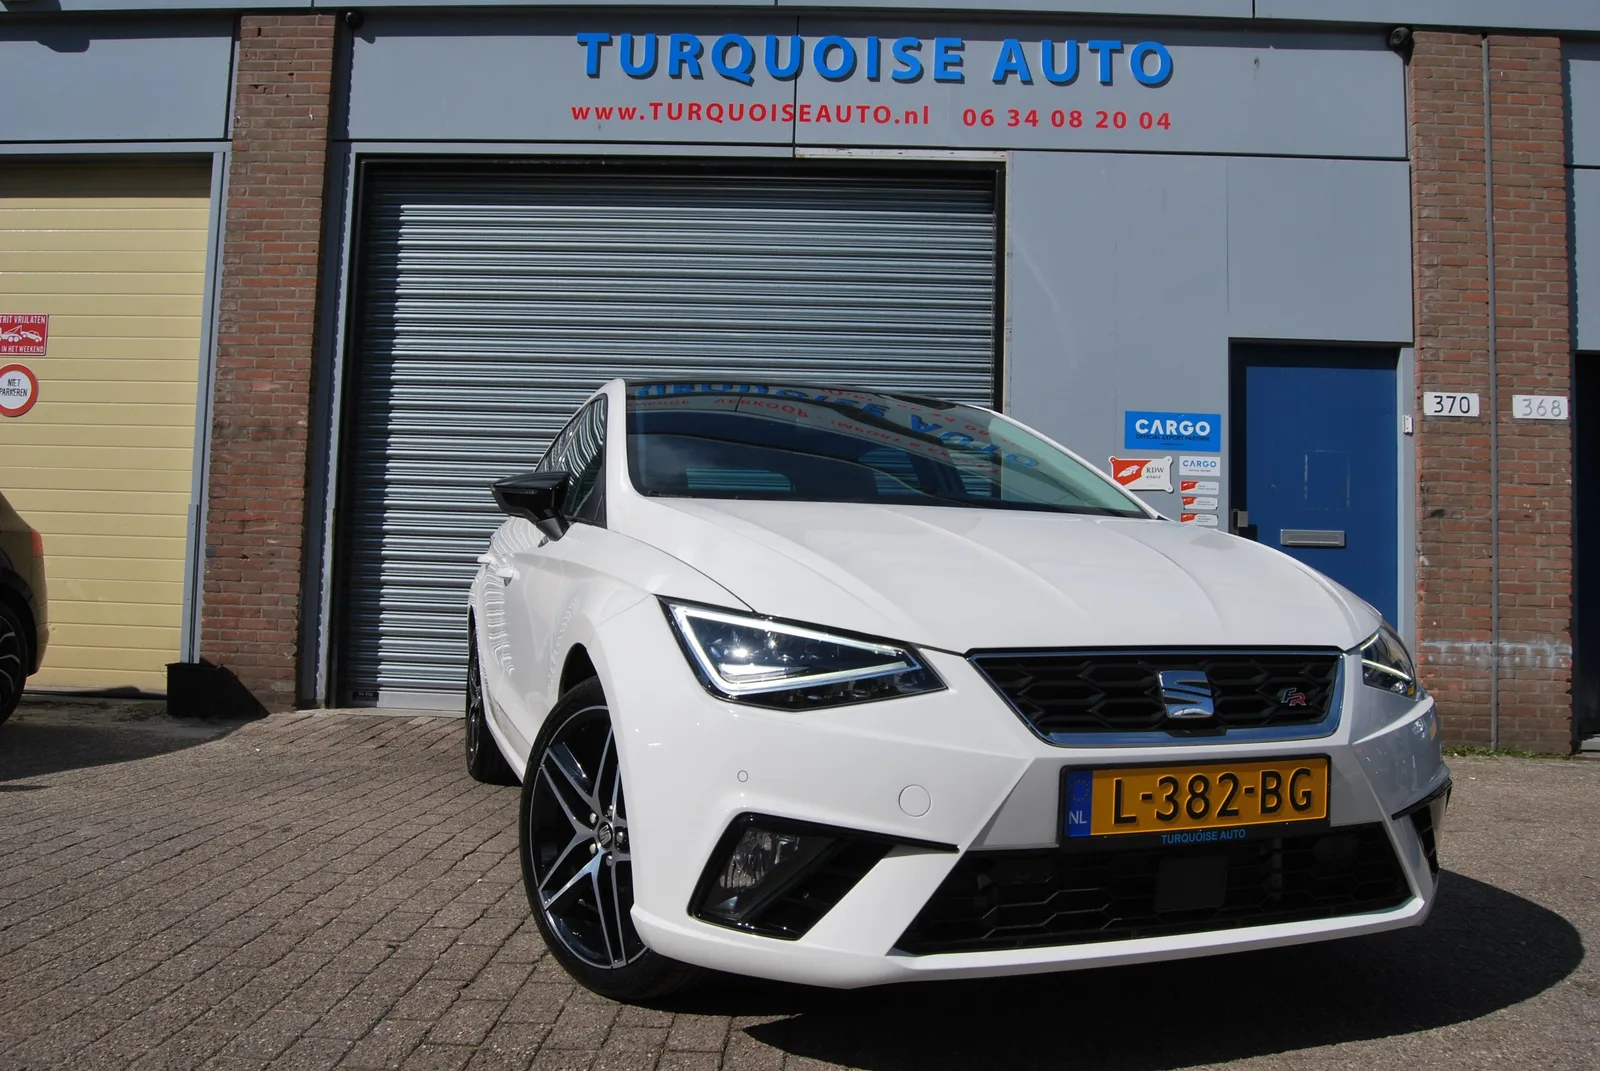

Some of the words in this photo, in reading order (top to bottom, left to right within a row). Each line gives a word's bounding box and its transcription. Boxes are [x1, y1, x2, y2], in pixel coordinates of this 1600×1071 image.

[576, 33, 965, 86] TURQUOISE
[992, 39, 1173, 87] AUTO
[571, 102, 929, 124] www.TURQUOISEAUTO.nl
[962, 109, 995, 127] 06
[1007, 109, 1039, 128] 34
[1051, 110, 1083, 128] 08
[1095, 110, 1127, 129] 20
[1139, 112, 1171, 130] 04
[14, 315, 45, 323] VRIJLATEN
[7, 378, 21, 387] NIET
[1433, 395, 1470, 414] 370
[1521, 398, 1562, 417] 368
[1135, 419, 1210, 436] CARGO
[1183, 460, 1217, 468] CARGO
[1113, 768, 1312, 825] L-382-BG
[1068, 810, 1087, 825] NL
[1161, 831, 1218, 844] TURQUOISE
[1220, 829, 1246, 841] AUTO
